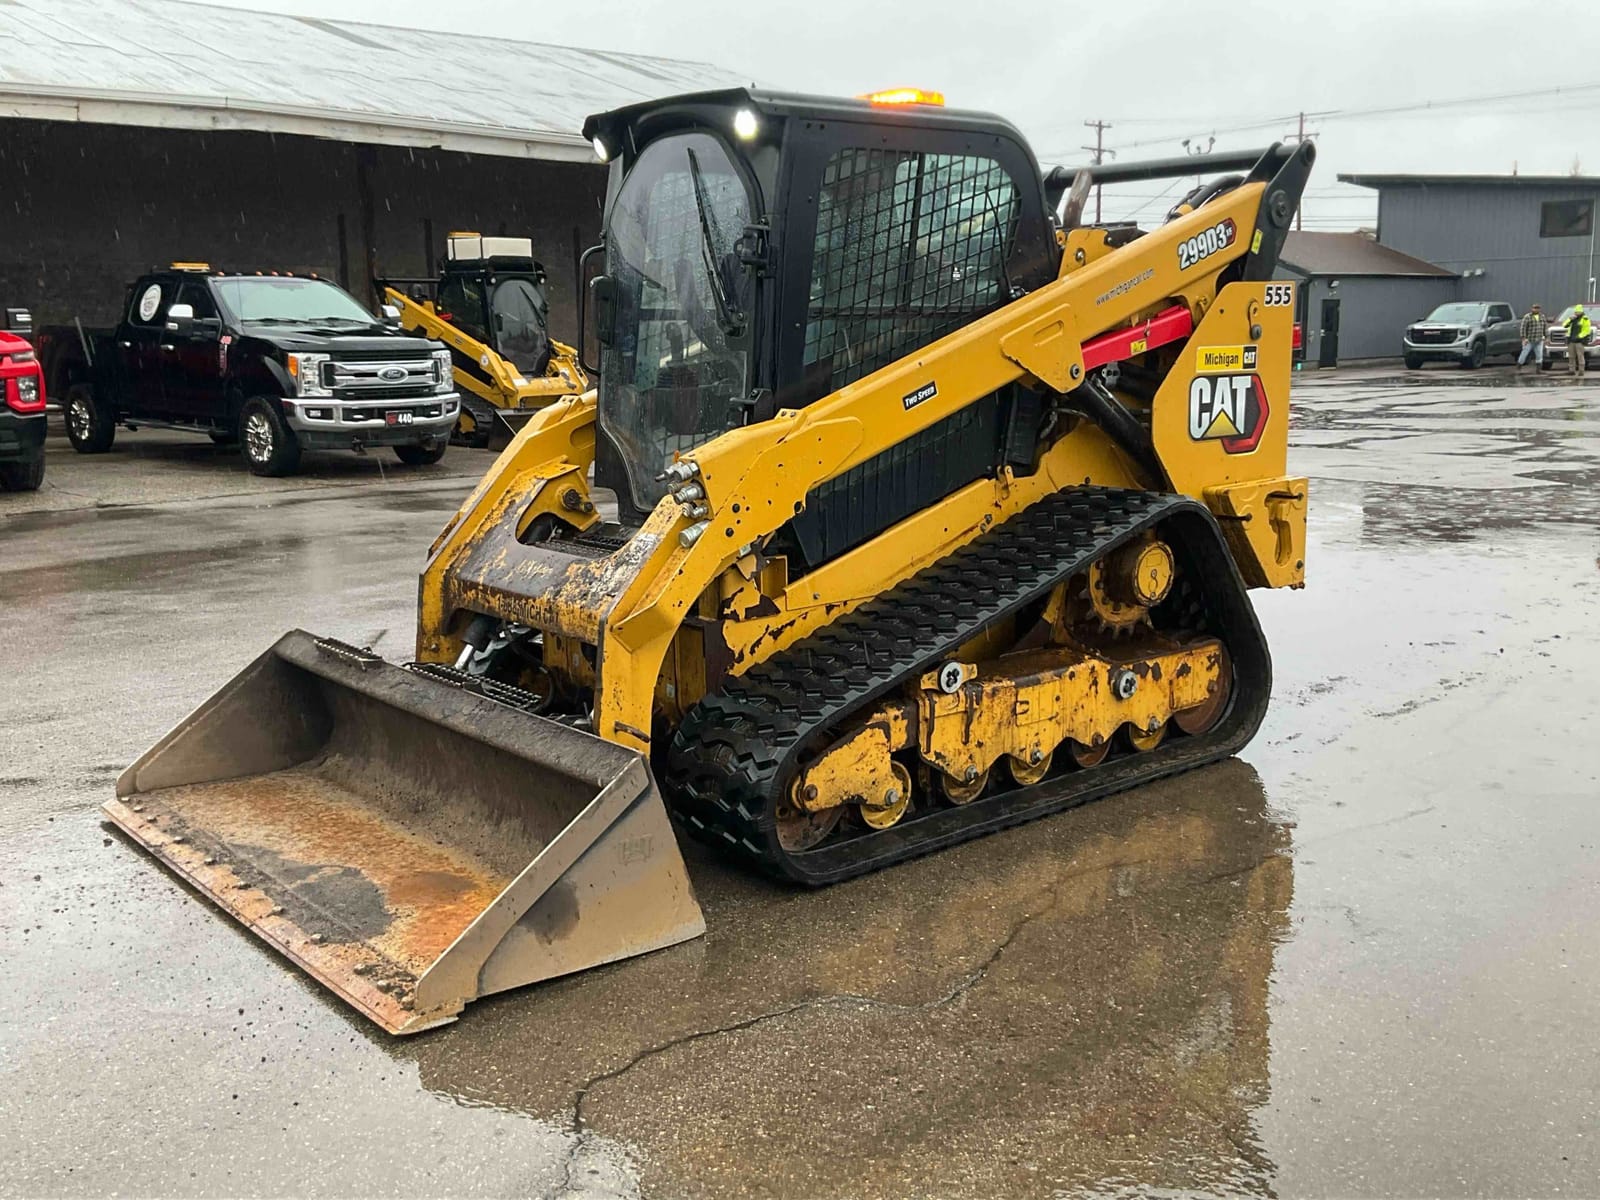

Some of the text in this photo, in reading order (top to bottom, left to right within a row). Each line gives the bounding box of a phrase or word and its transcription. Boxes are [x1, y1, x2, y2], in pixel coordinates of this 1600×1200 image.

[1178, 222, 1227, 270] 299D3
[1264, 284, 1292, 306] 555
[1204, 351, 1256, 367] Michigan CAT
[398, 413, 412, 423] 440
[1189, 375, 1252, 439] CAT
